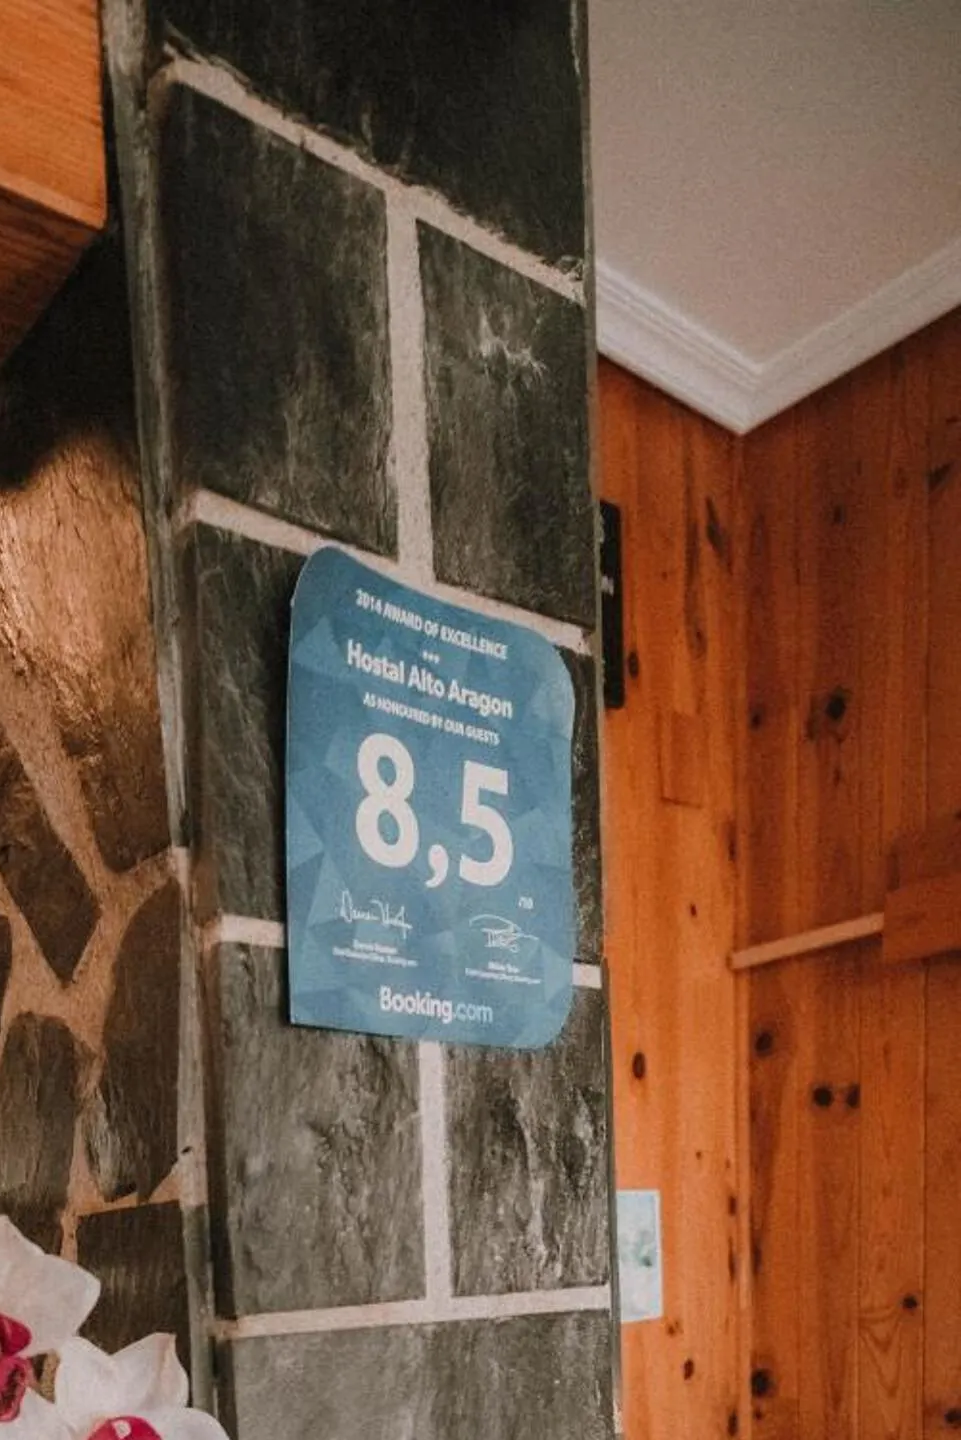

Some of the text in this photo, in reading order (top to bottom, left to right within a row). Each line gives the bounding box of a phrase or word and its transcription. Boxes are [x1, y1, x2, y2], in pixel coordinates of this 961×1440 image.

[382, 602, 423, 632] AWARD
[424, 619, 439, 638] OF
[440, 625, 509, 661] EXCELLENCE
[347, 638, 514, 720] Hostal Alto Aragon
[465, 722, 501, 747] GUESTS
[355, 733, 514, 888] 8,5
[380, 984, 494, 1025] Booking.com
